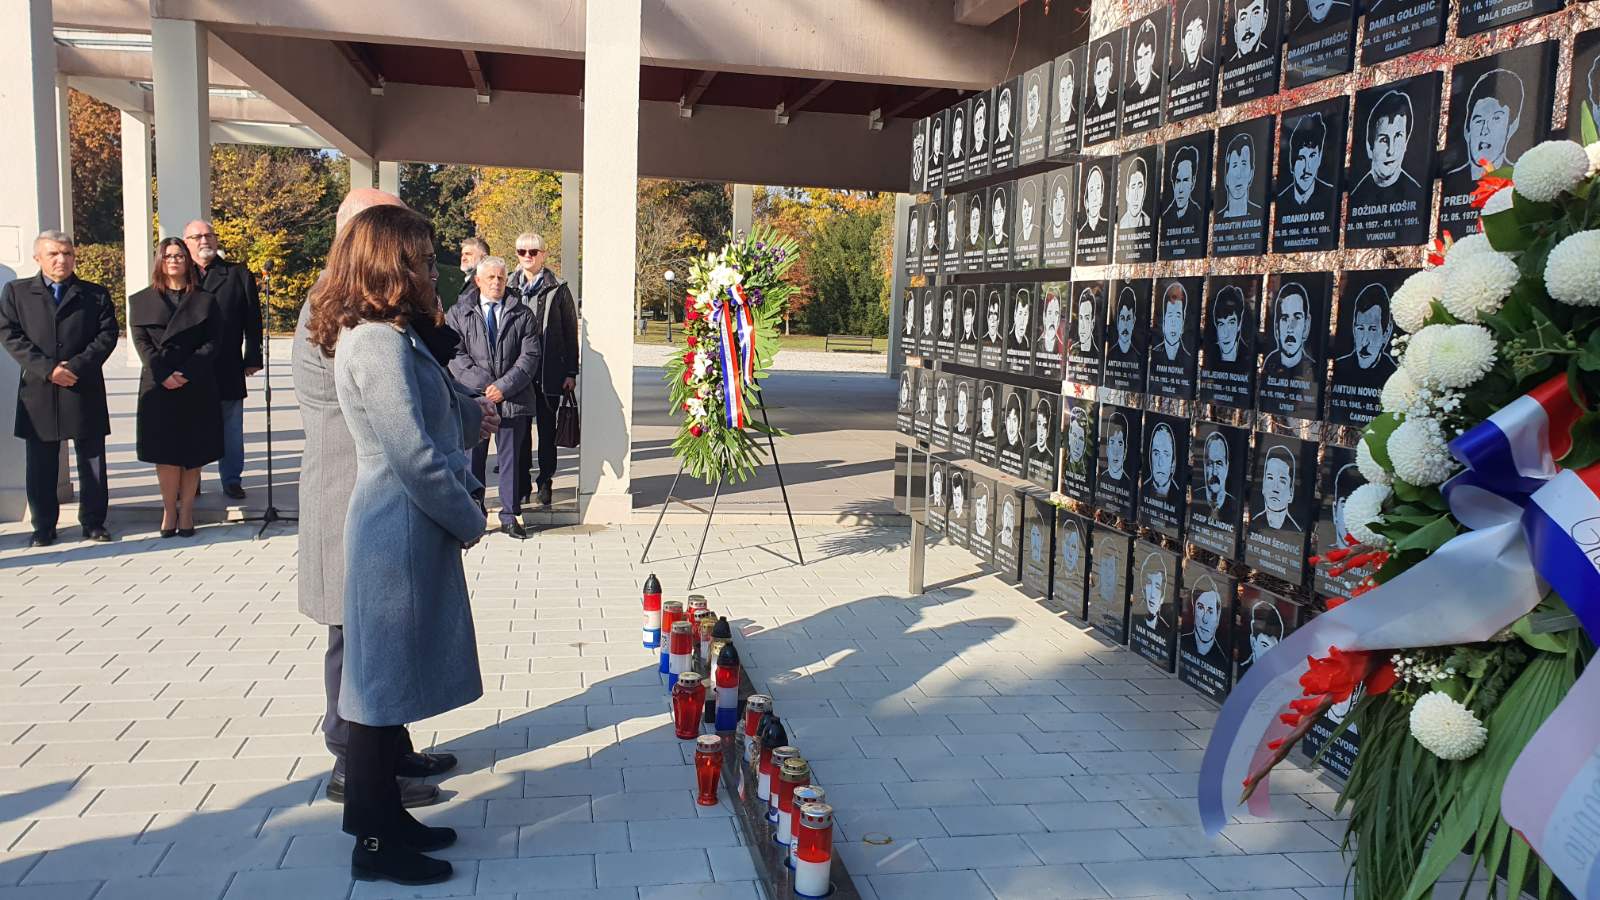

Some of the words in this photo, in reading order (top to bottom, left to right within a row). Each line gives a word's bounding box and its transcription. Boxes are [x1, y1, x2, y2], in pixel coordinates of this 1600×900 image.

[1478, 11, 1499, 24] MALA
[1501, 0, 1533, 16] DEREZA
[1369, 14, 1394, 32] DAMIR
[1288, 40, 1320, 60] DRAGUTIN
[1224, 66, 1246, 80] RADOVAN
[1352, 204, 1388, 216] BOŽIDAR
[1390, 200, 1417, 212] KOŠIR
[1282, 214, 1308, 224] BRANKO
[1310, 212, 1325, 221] KOS
[1440, 214, 1450, 222] 12.
[1450, 212, 1460, 220] 05.
[1214, 222, 1241, 232] DRAGUTIN
[1466, 224, 1478, 233] DU
[1202, 370, 1229, 380] MILJENKO
[1229, 373, 1248, 382] NOVAK
[1267, 375, 1288, 387] ŽELJKO
[1290, 380, 1311, 390] NOVAK
[1332, 384, 1357, 395] ANTUN
[1358, 386, 1382, 398] NOVOS
[1250, 532, 1272, 546] ZORAN
[1272, 538, 1300, 556] ŠEGOVIĆ
